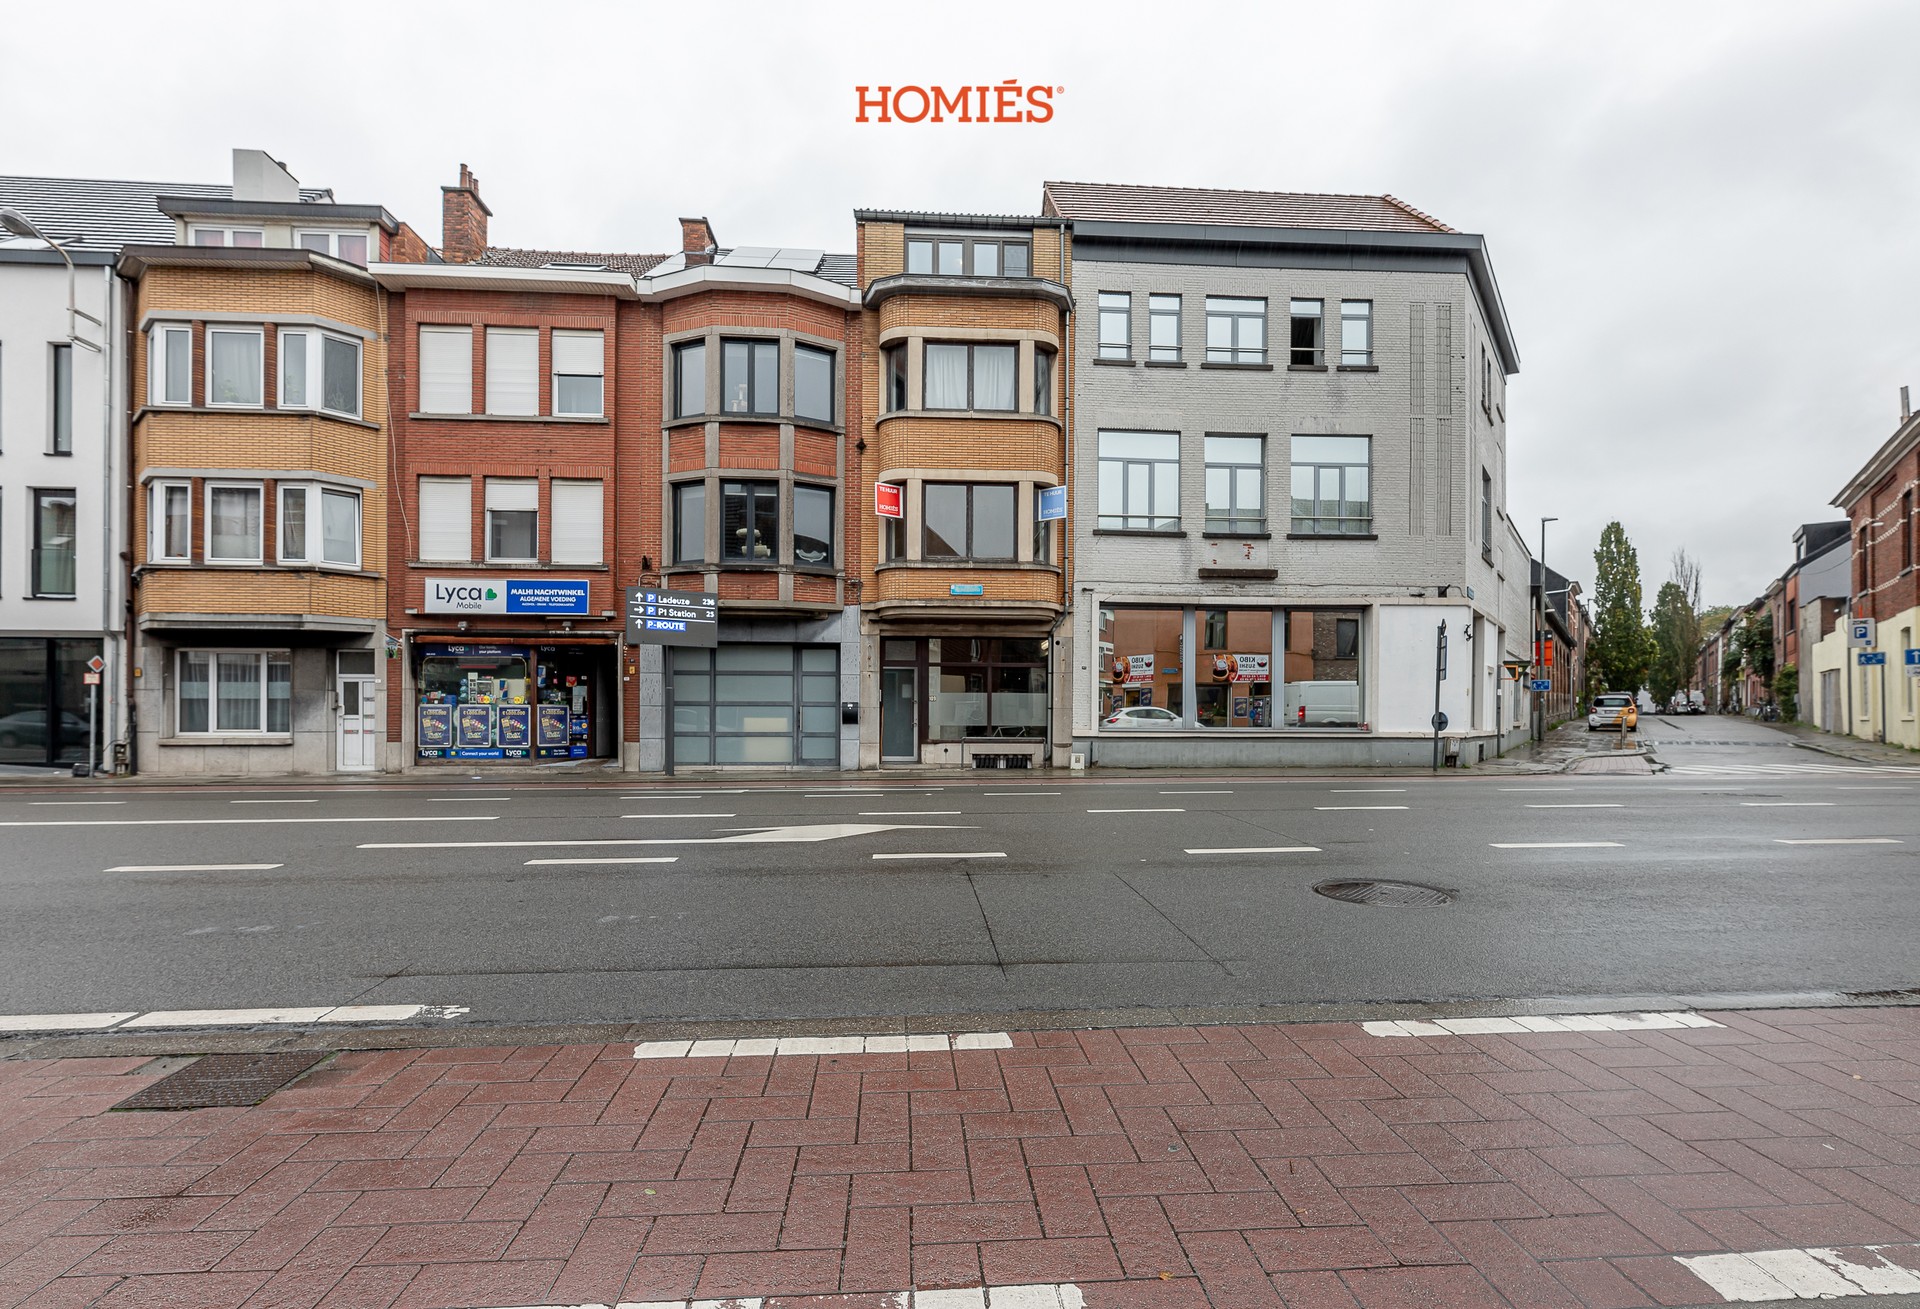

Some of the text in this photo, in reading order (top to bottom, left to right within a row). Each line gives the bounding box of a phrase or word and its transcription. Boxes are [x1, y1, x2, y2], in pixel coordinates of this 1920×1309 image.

[436, 583, 482, 604] Lyca
[534, 588, 585, 596] NACHTWINKEL
[648, 594, 715, 606] P Ladeuze 236
[456, 602, 482, 610] Mobile
[648, 606, 715, 618] P P1 Station 25
[647, 621, 686, 631] P-ROUTE
[1856, 627, 1866, 638] P
[447, 645, 464, 653] Lyca
[422, 749, 438, 757] Lyca
[505, 749, 522, 757] Lyca
